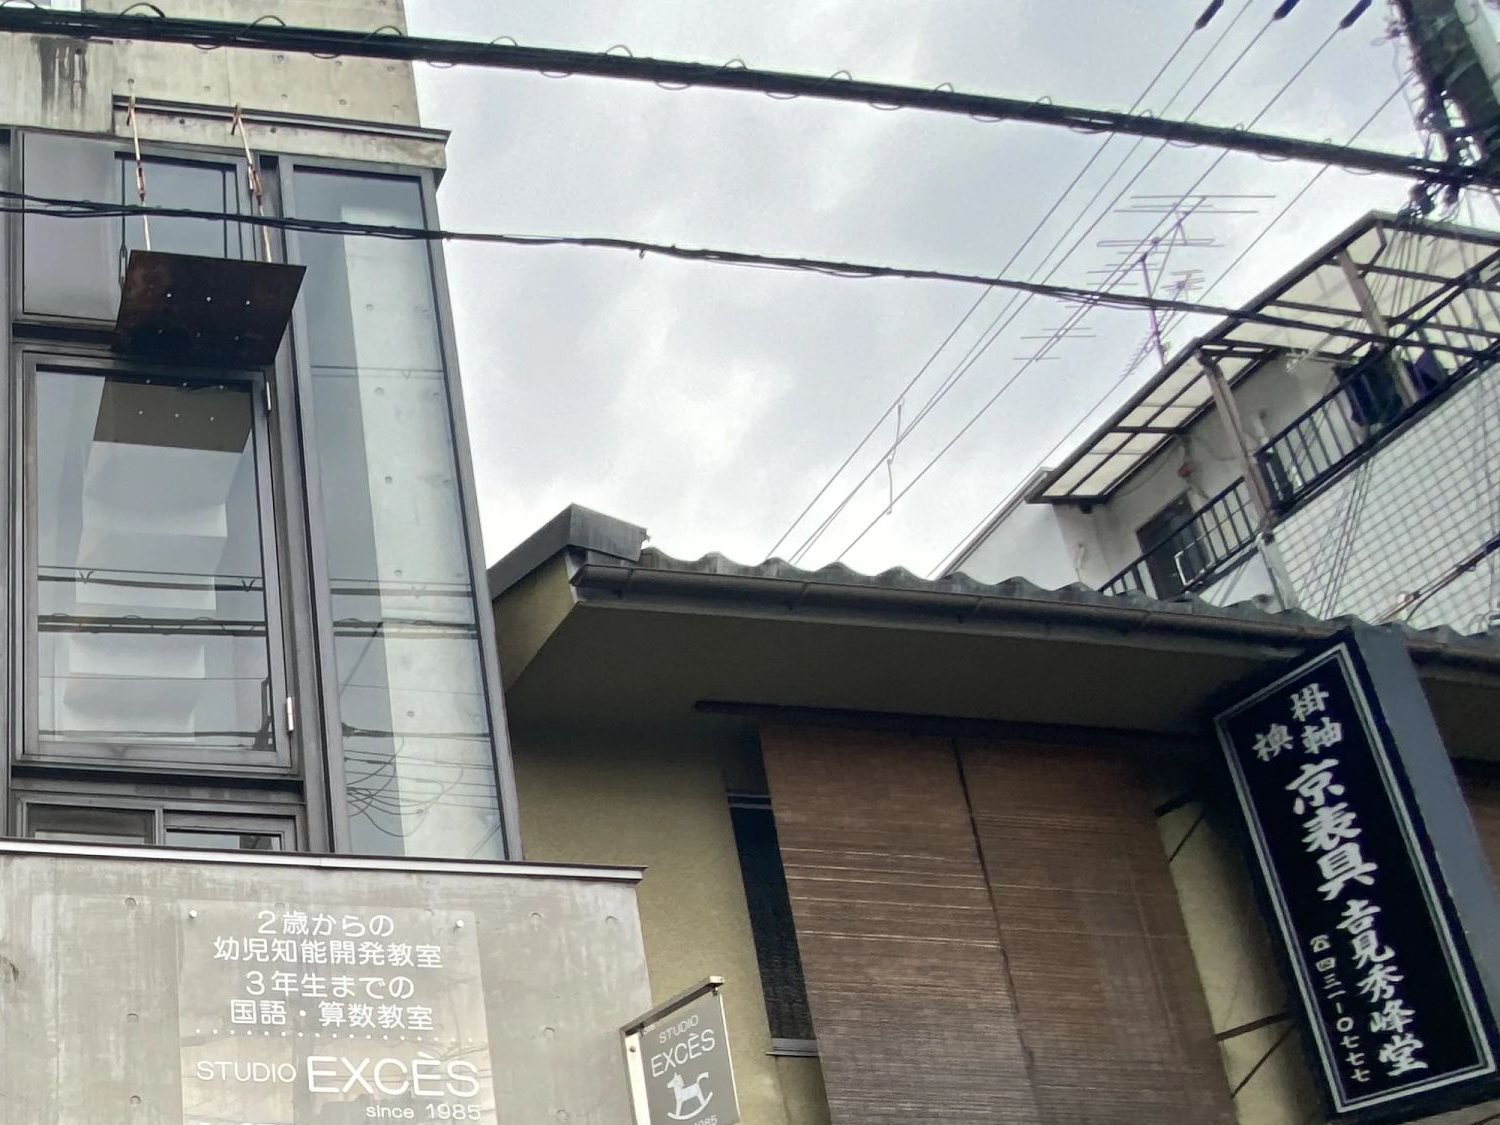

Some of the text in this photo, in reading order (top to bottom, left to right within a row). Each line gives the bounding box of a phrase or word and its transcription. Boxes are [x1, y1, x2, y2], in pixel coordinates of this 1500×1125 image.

[1285, 758, 1378, 901] 京表具
[258, 910, 394, 937] 2歳からの
[213, 936, 443, 968] 幼児知能開発教室
[246, 970, 415, 999] 3年生までの
[230, 1000, 434, 1031] 国語・算数教室
[659, 1015, 699, 1043] STUDIO
[196, 1052, 480, 1097] STUDIO EXCÈS
[366, 1104, 481, 1121] since 1985
